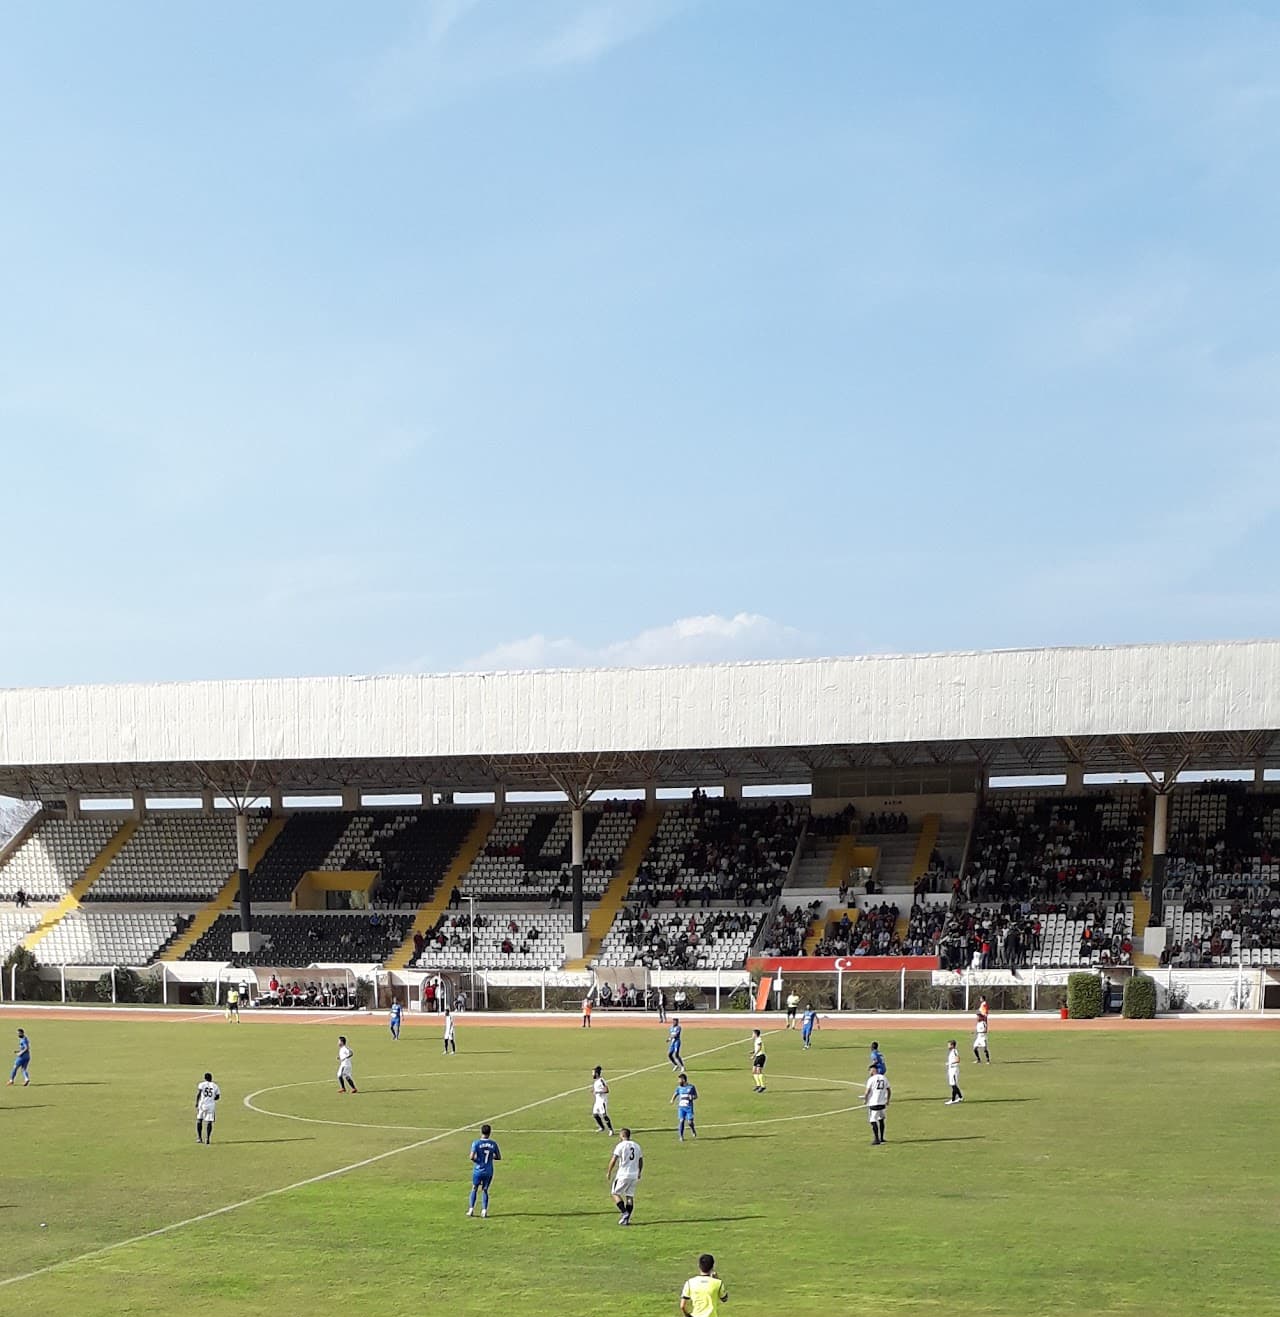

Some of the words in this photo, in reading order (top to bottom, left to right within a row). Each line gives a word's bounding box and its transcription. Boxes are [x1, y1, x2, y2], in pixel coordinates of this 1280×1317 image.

[319, 815, 418, 871] K
[876, 1079, 885, 1090] 23
[204, 1087, 213, 1098] 55
[483, 1149, 490, 1164] 7
[629, 1147, 635, 1161] 3
